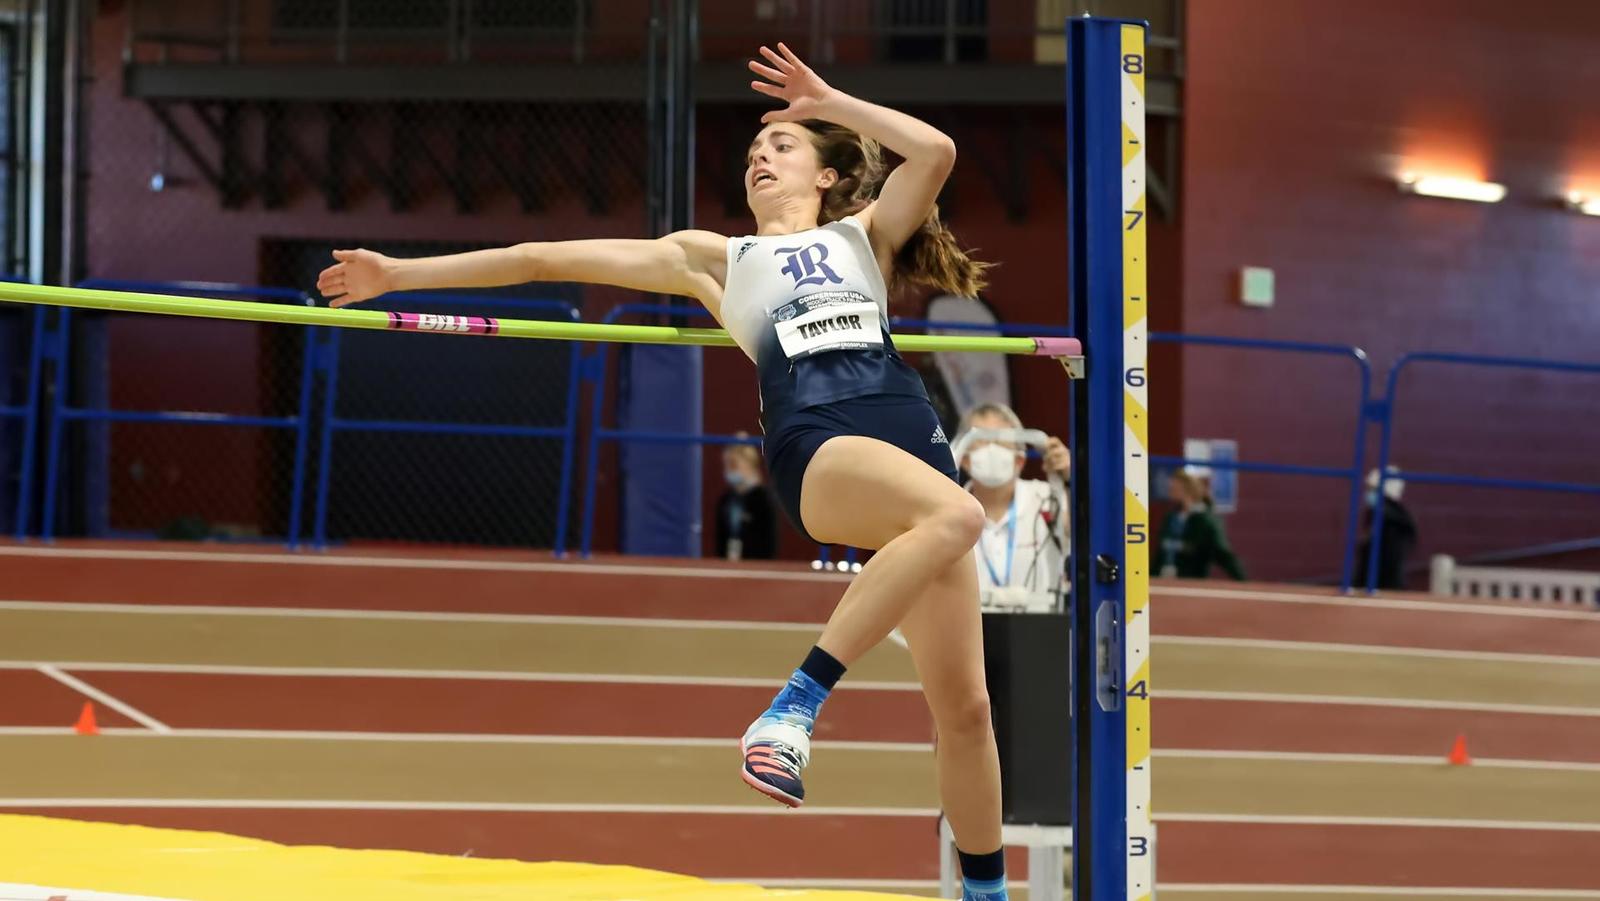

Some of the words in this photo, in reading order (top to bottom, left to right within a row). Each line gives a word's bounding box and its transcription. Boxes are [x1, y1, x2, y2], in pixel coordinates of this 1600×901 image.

[1123, 55, 1142, 74] 8
[1124, 210, 1143, 230] 7
[798, 291, 849, 304] CONFERENCE
[850, 292, 865, 301] USA
[417, 313, 470, 331] GILL
[797, 314, 862, 340] TAYLOR
[1125, 368, 1145, 387] 6
[1127, 524, 1145, 543] 5
[1127, 681, 1147, 700] 4
[1130, 837, 1146, 856] 3
